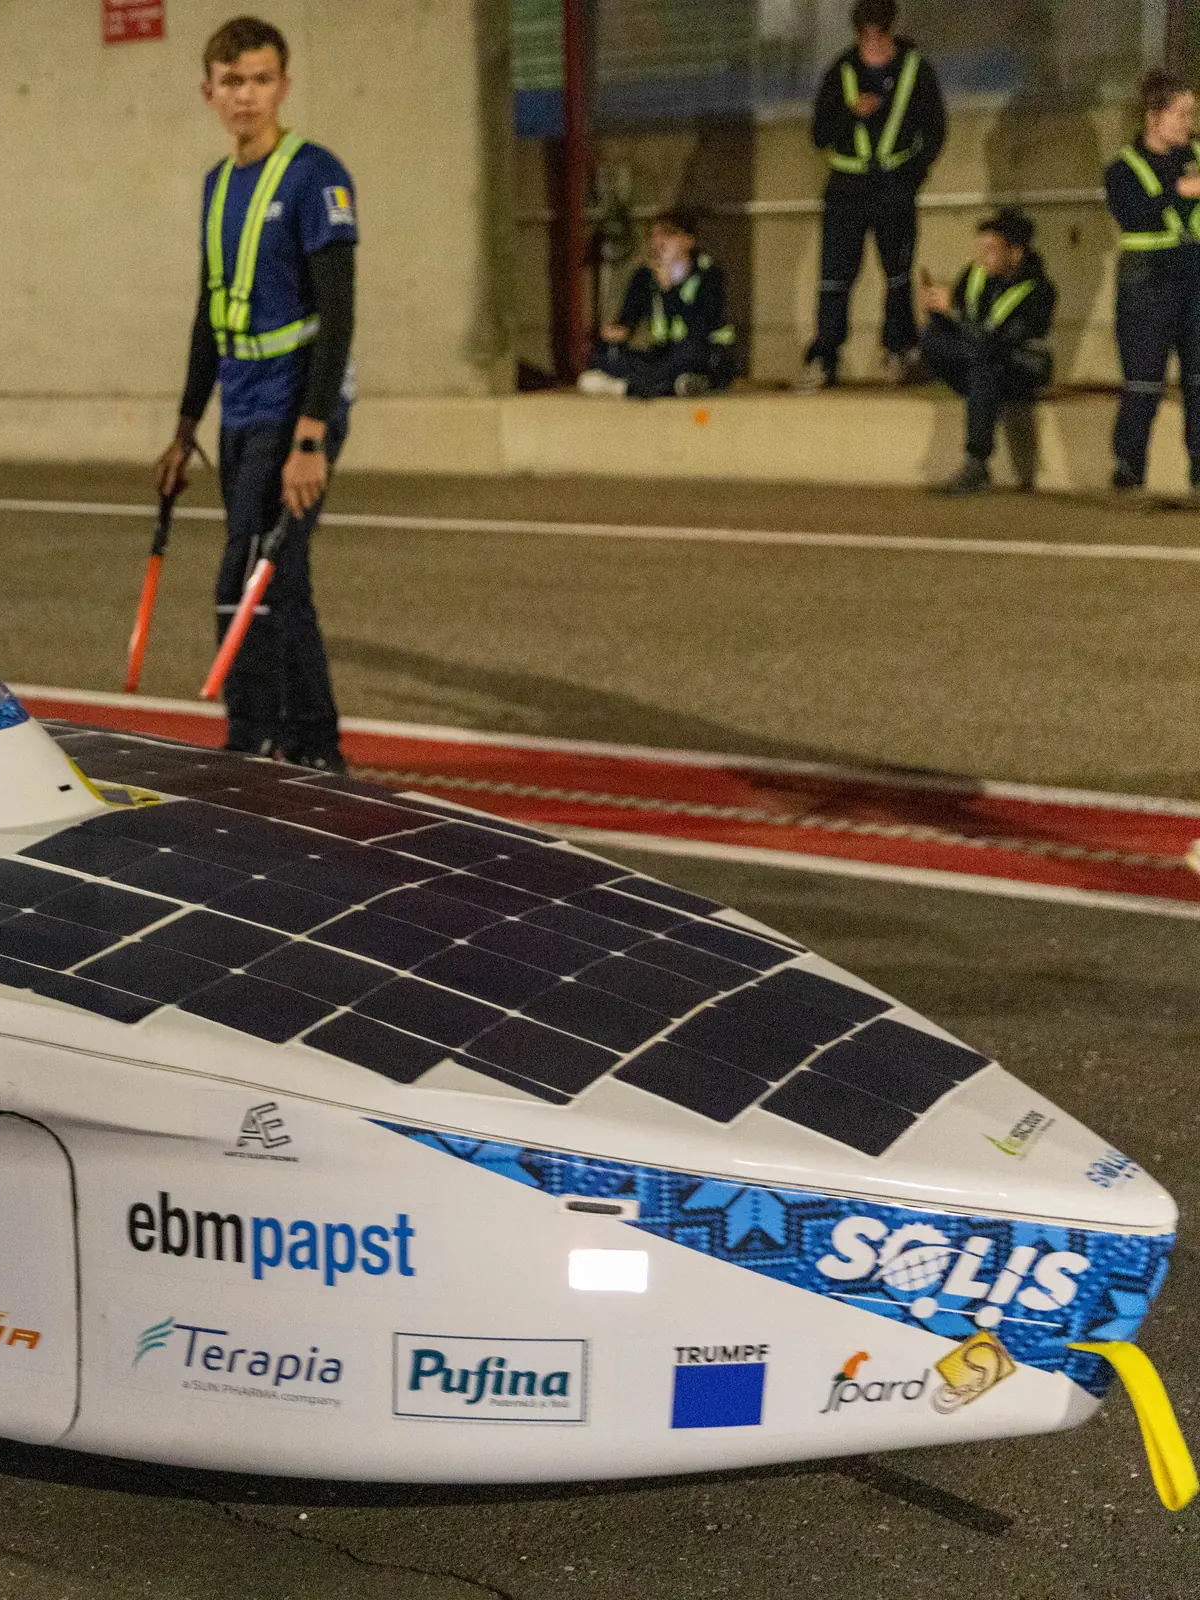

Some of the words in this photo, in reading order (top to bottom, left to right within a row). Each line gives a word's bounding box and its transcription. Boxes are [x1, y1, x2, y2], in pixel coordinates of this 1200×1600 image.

[127, 1190, 416, 1286] ebmpapst
[816, 1215, 1091, 1312] SOLIS
[173, 1323, 343, 1386] Terapia
[407, 1348, 570, 1406] Pufina
[674, 1344, 770, 1364] TRUMPF
